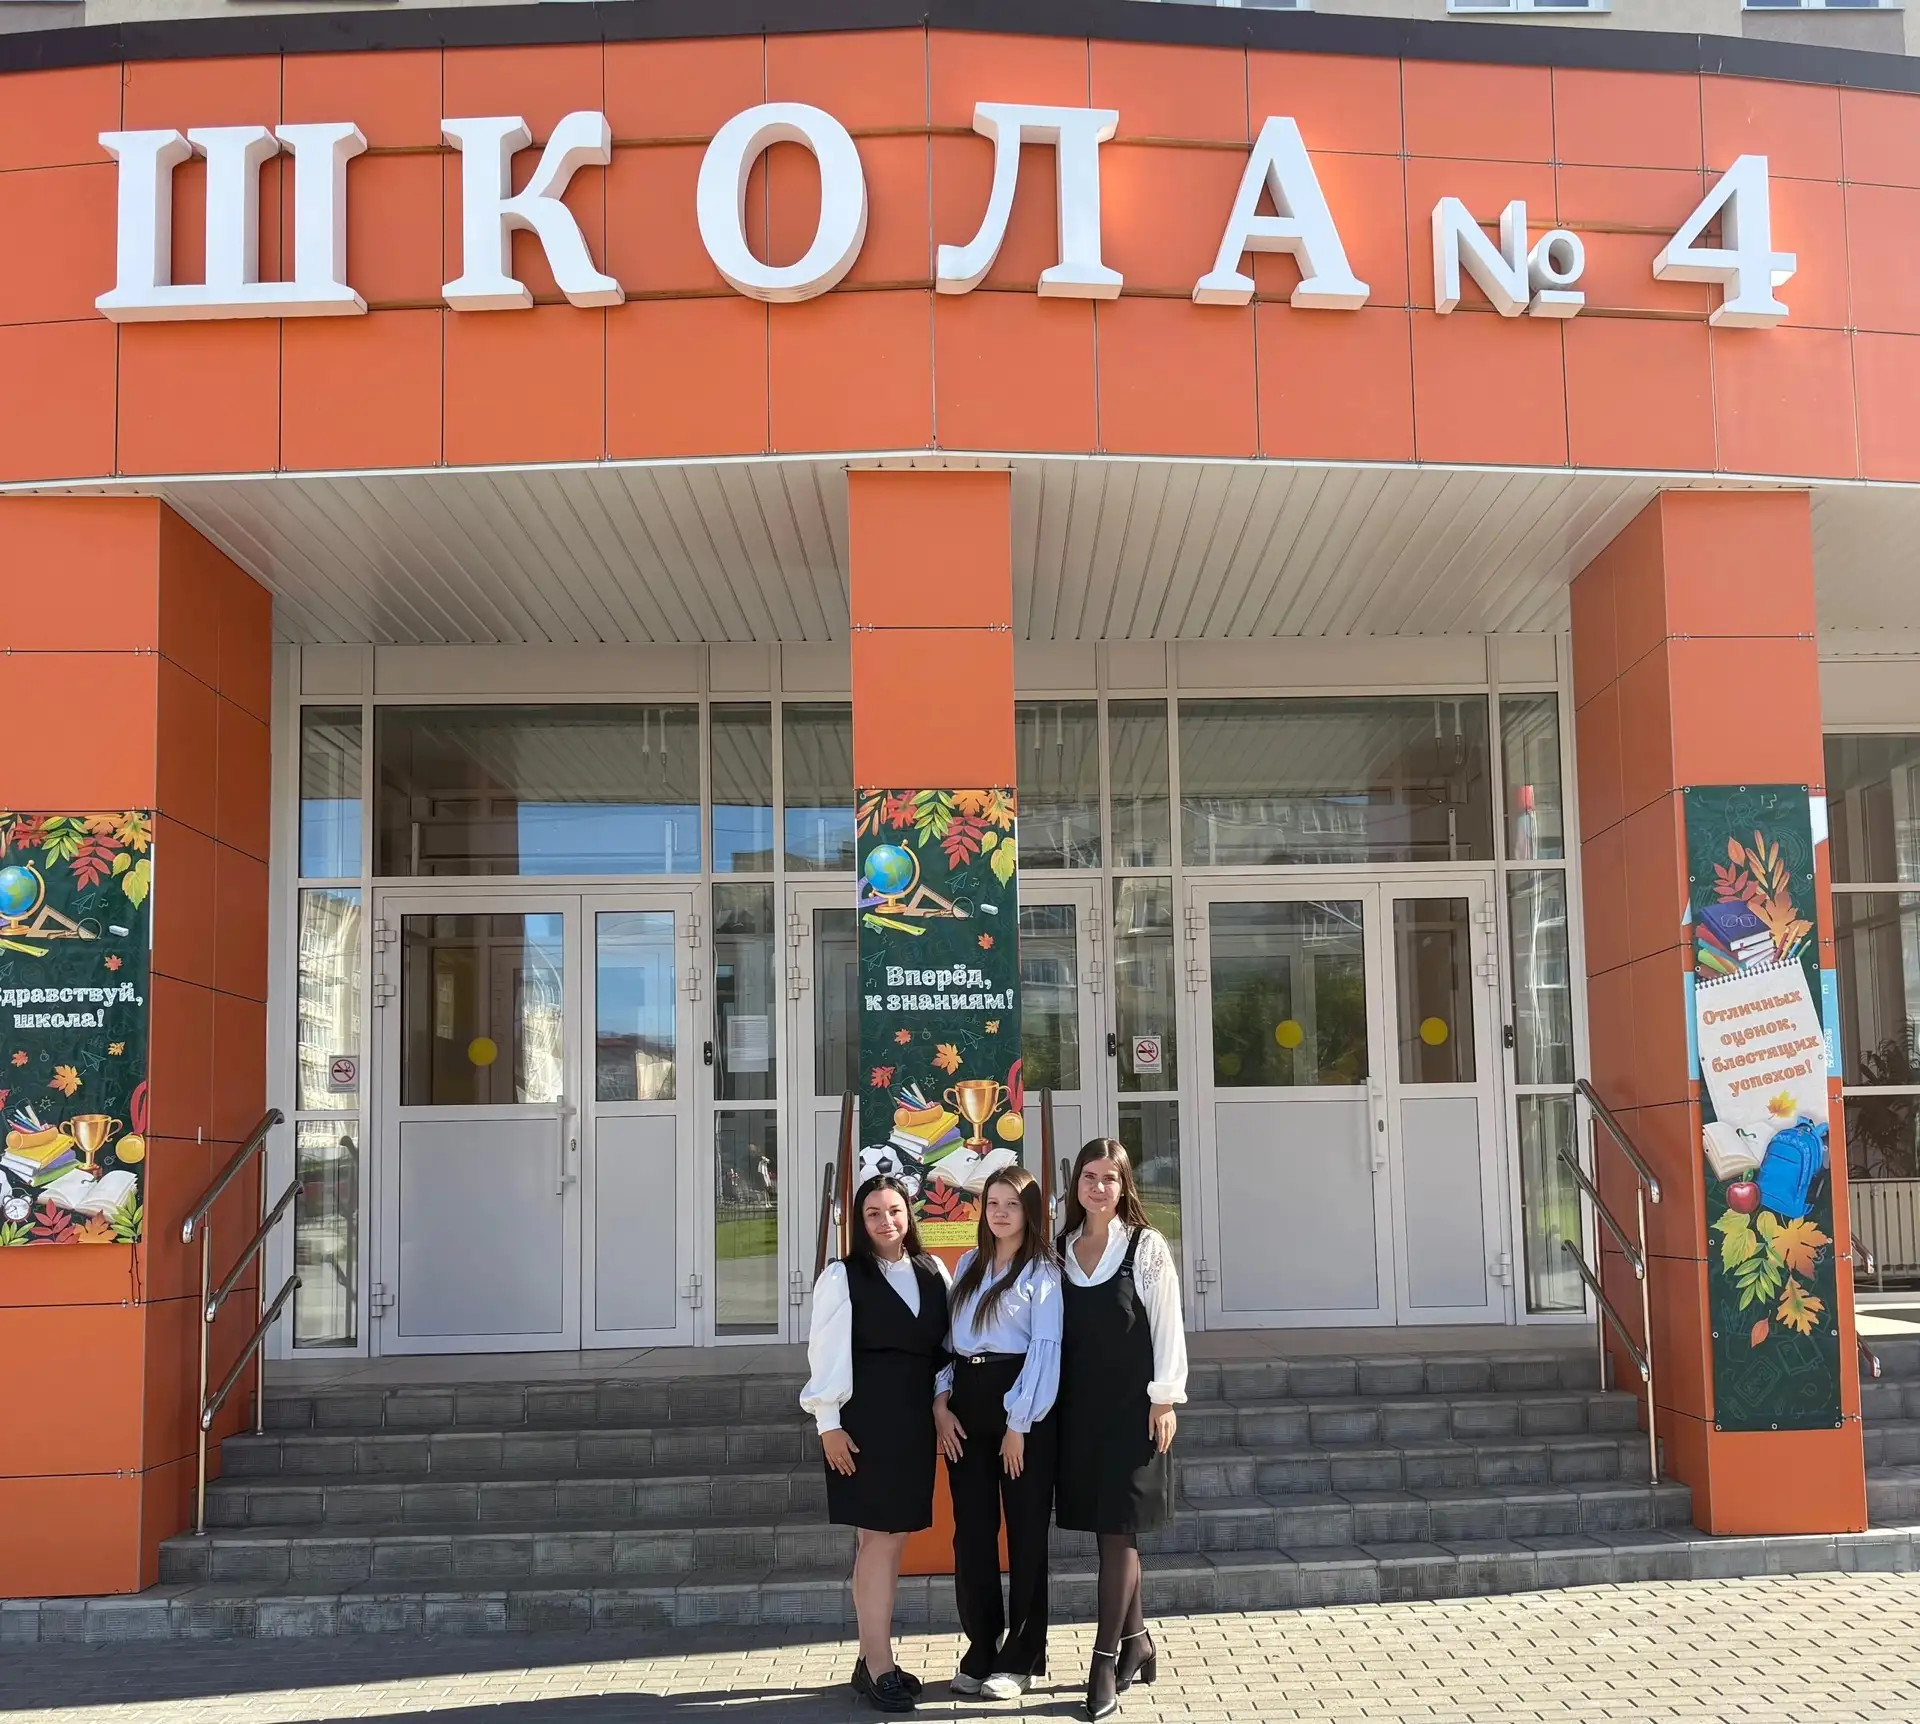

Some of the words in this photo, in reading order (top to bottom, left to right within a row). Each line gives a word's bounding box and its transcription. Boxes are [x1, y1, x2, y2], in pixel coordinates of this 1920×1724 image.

[95, 101, 1370, 323] ШКОЛА
[1431, 196, 1585, 319] №
[1652, 154, 1797, 330] 4
[885, 963, 992, 991] Вперёд,
[0, 982, 143, 1008] дравствуй,
[864, 994, 883, 1011] к
[886, 988, 1014, 1010] знаниям!
[1702, 989, 1803, 1025] Отличных
[13, 1008, 105, 1028] школа!
[1720, 1017, 1797, 1047] оценок,
[1711, 1035, 1820, 1073] блестящих
[1728, 1058, 1813, 1097] успехов!
